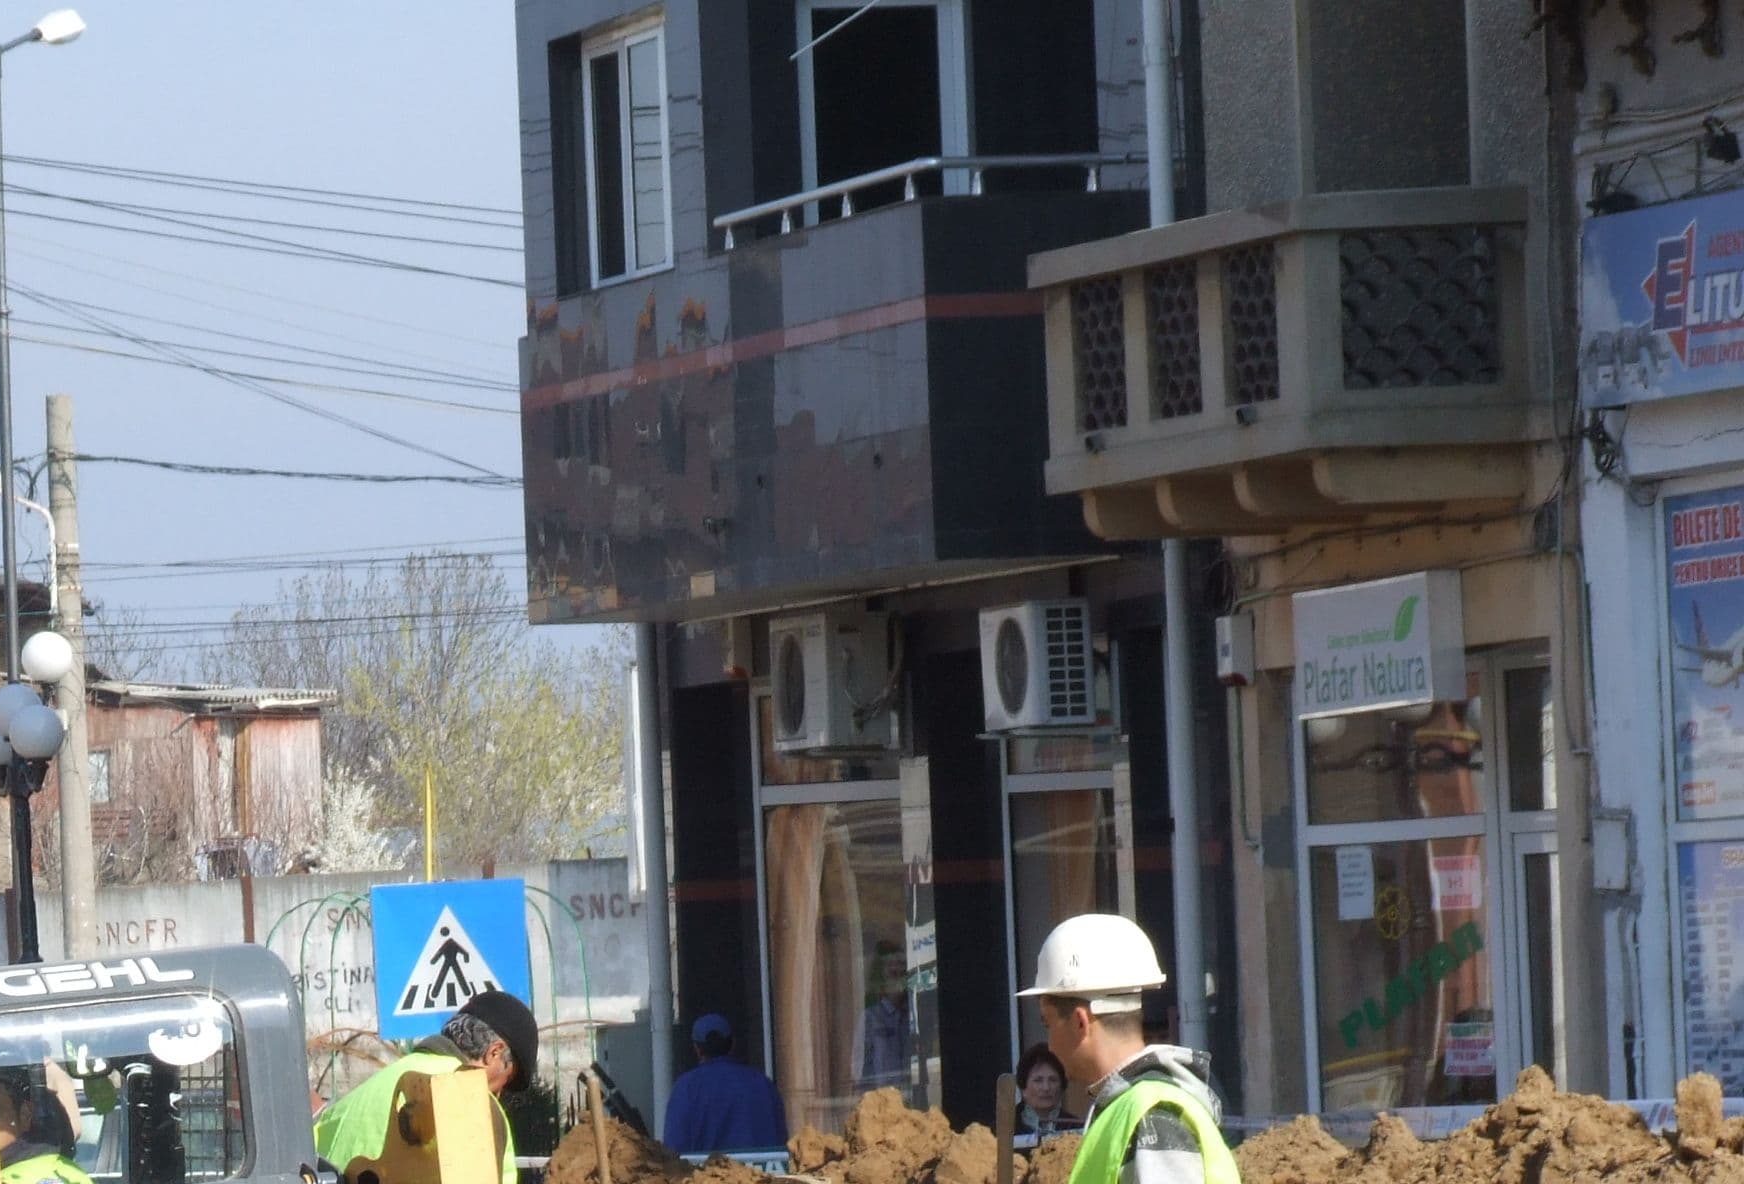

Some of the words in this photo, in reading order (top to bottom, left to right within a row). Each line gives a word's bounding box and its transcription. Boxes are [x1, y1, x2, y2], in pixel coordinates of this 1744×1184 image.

[1672, 505, 1720, 548] BILETE
[1303, 655, 1356, 706] Plafar
[1362, 651, 1426, 698] Natura
